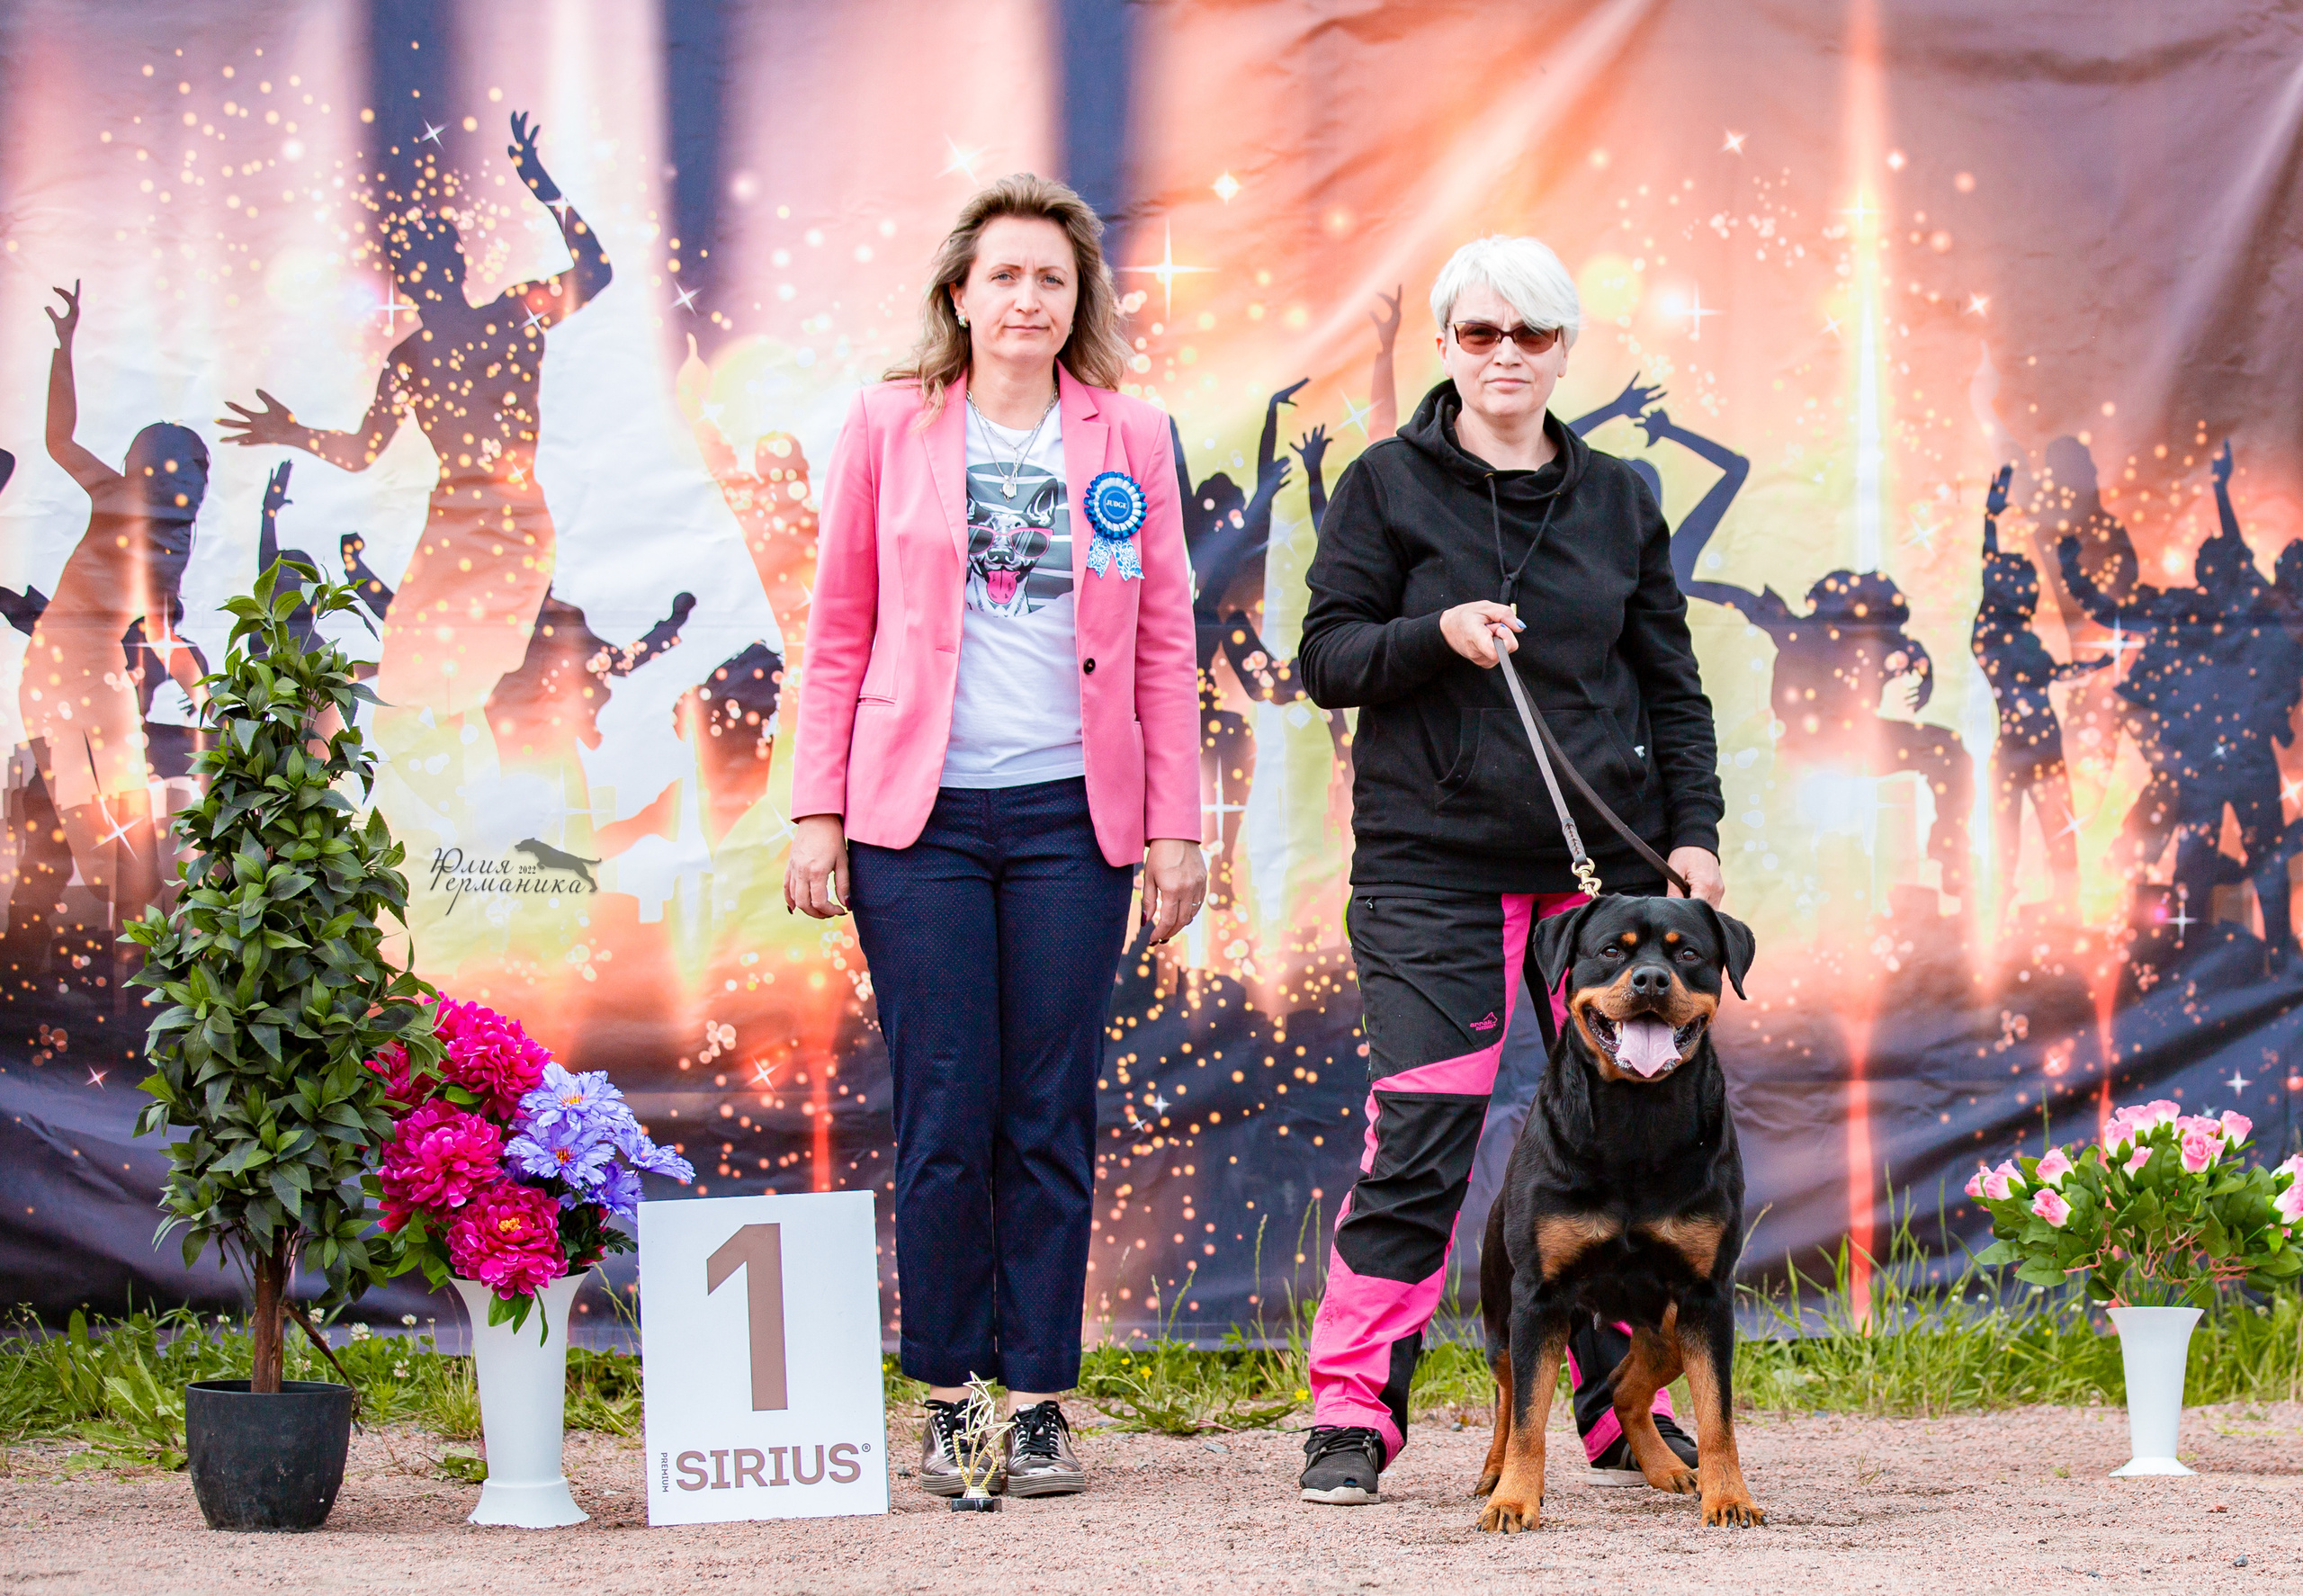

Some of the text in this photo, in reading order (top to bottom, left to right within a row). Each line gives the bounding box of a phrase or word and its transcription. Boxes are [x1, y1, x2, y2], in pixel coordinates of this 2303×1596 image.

[1107, 499, 1127, 509] JUDGE
[706, 1223, 788, 1412] 1
[660, 1452, 669, 1493] PREMIUM
